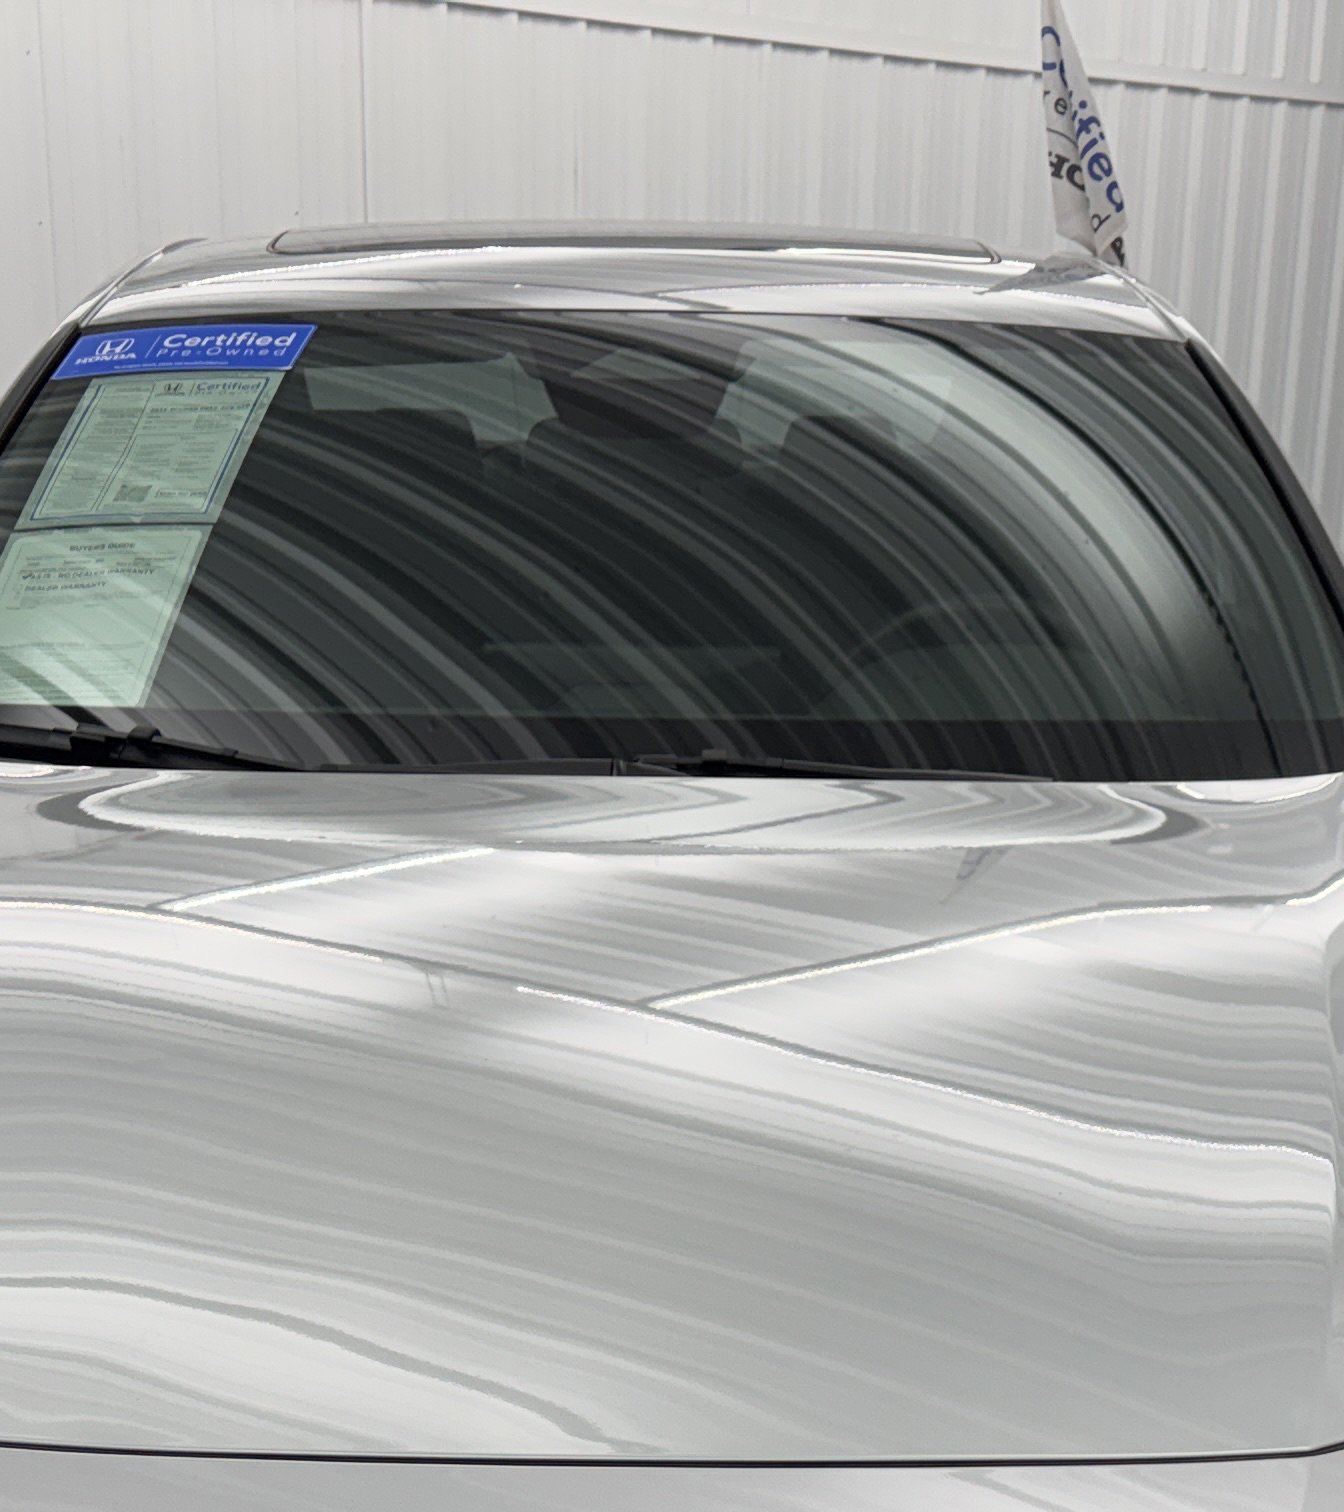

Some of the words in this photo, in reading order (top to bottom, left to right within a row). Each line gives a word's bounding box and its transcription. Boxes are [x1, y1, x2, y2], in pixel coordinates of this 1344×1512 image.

[163, 332, 297, 348] Certified
[75, 352, 137, 365] HONDA
[156, 346, 287, 358] Pre-Owned
